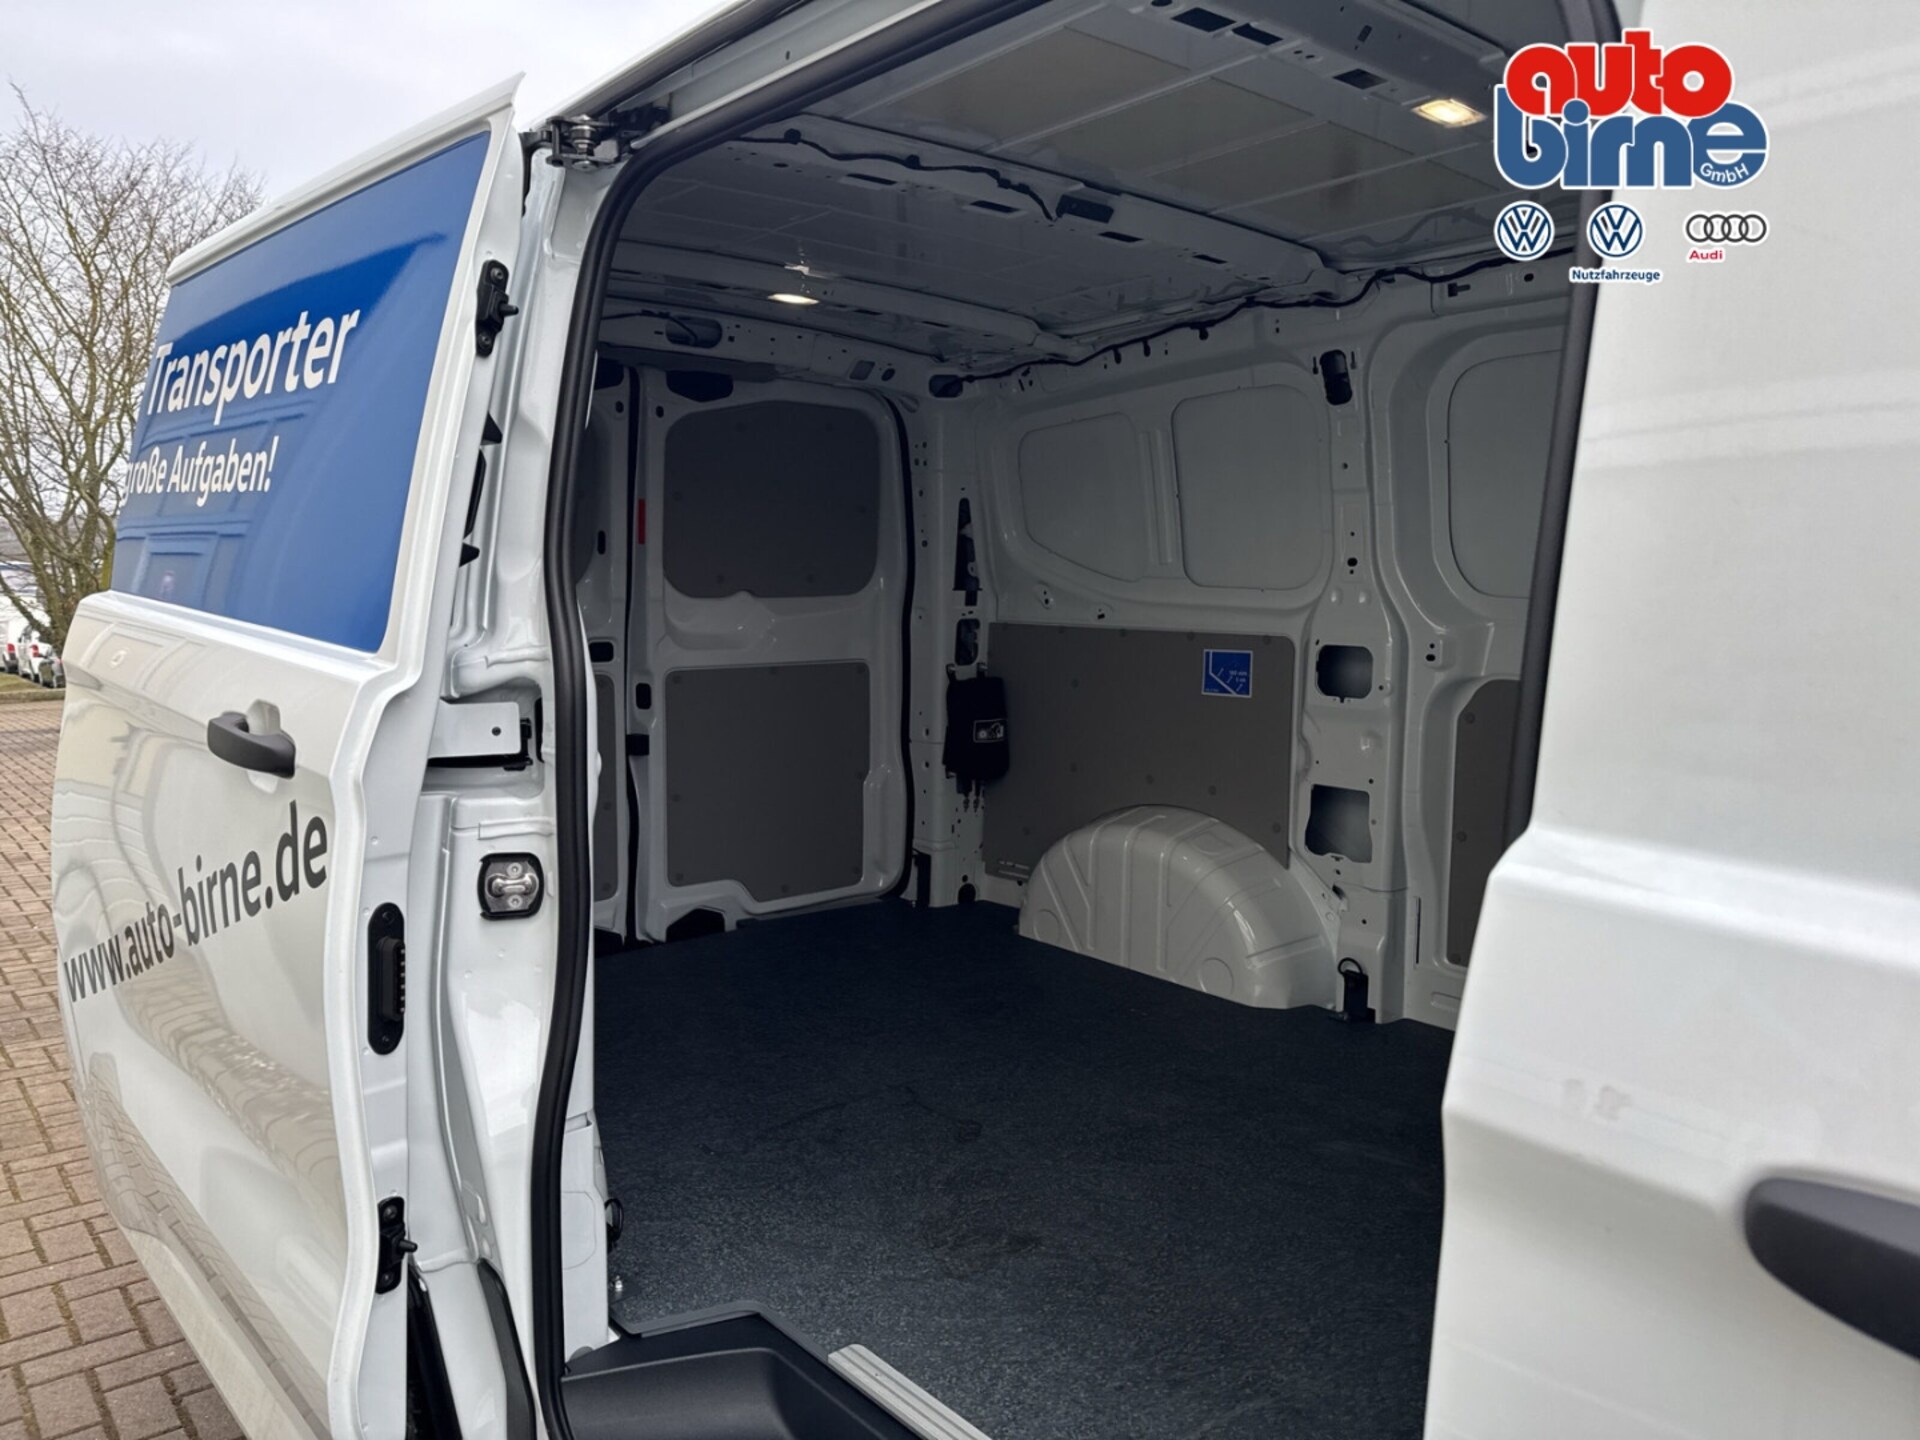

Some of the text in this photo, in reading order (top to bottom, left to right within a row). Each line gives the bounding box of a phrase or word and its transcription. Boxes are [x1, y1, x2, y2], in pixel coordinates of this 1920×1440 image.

[147, 309, 361, 426] Transporter
[166, 435, 280, 508] Aufgaben!
[63, 799, 328, 1003] www.auto-birne.de
